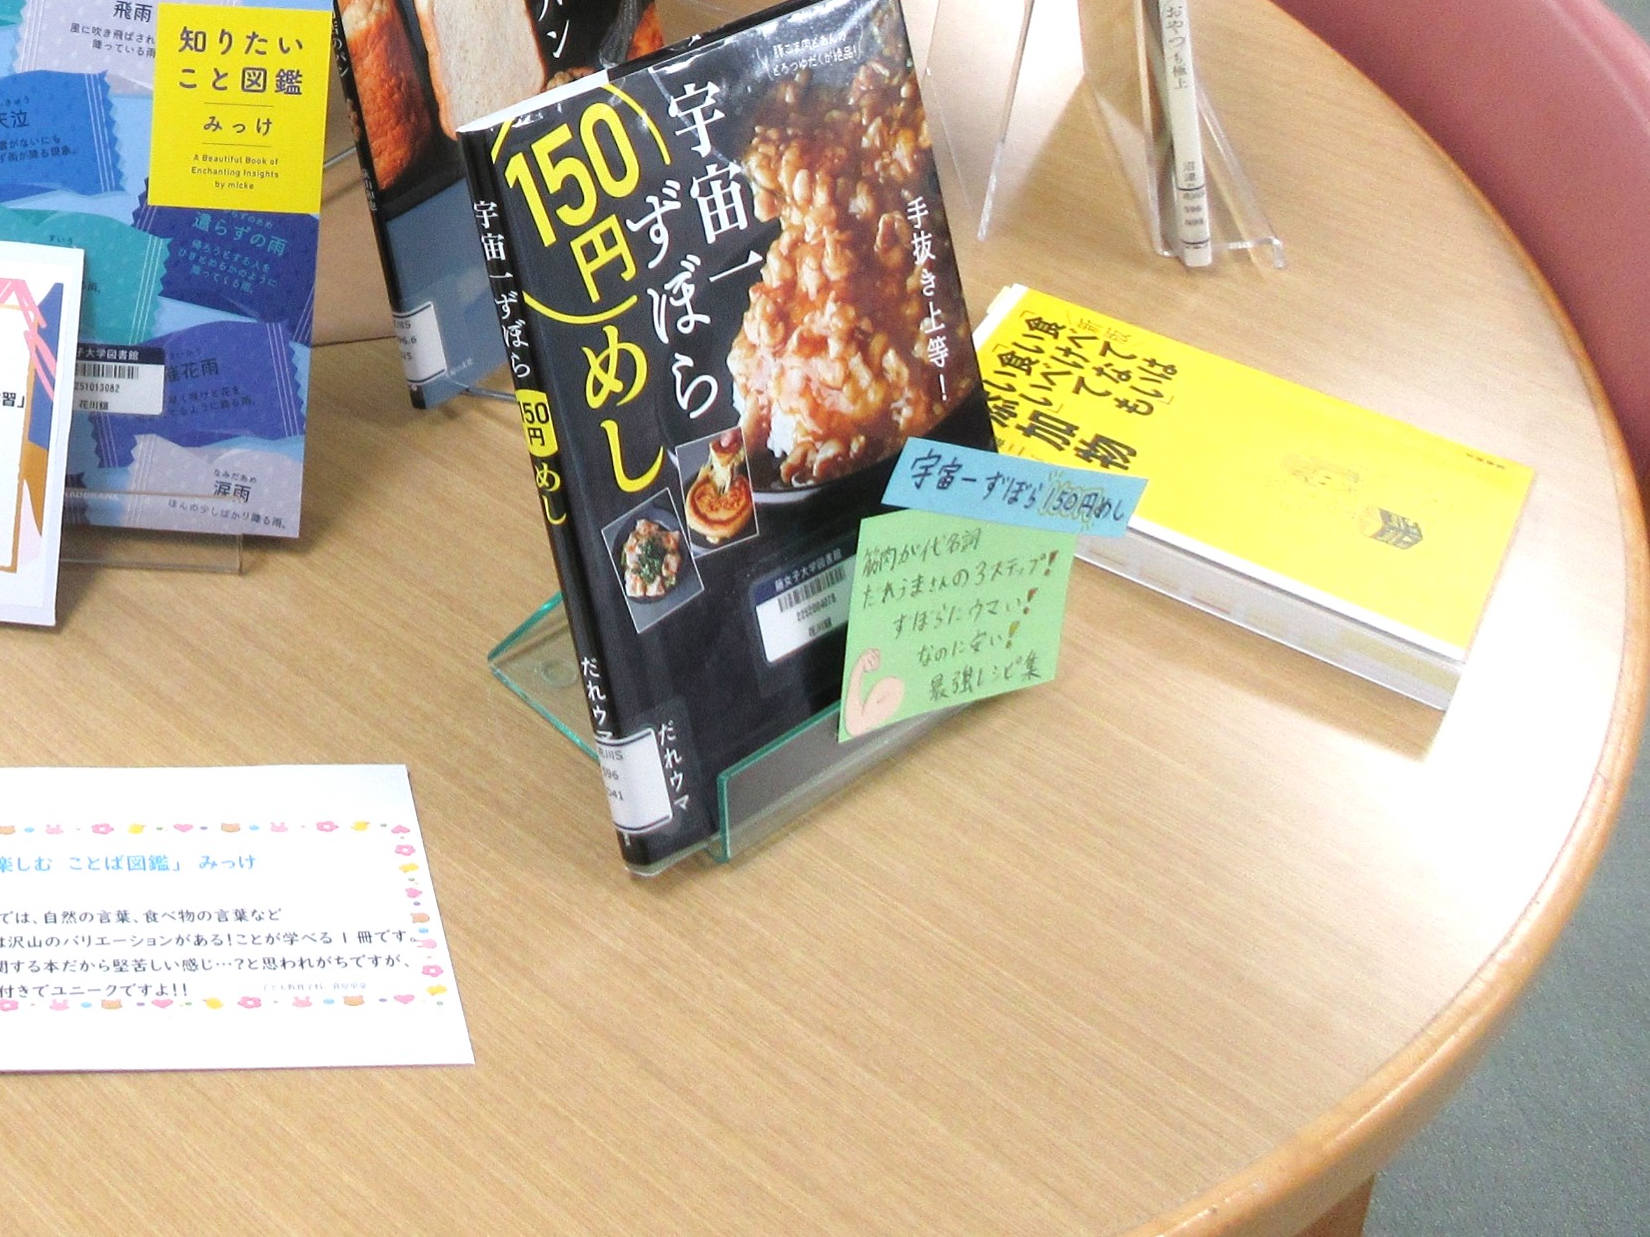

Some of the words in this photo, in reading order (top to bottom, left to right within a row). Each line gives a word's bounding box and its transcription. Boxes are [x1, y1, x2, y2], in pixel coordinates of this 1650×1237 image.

[113, 0, 153, 23] 飛雨
[178, 26, 303, 56] 知りたい
[178, 67, 303, 96] こと図鑑
[203, 115, 272, 137] みっけ
[192, 153, 200, 162] A
[202, 154, 243, 164] Beautiful
[245, 156, 267, 166] Book
[269, 158, 279, 166] of
[191, 166, 241, 178] Enchanting
[243, 168, 280, 180] Insights
[668, 80, 763, 285] 宇宙一
[214, 180, 226, 191] by
[626, 179, 719, 419] ずぼら
[658, 719, 690, 810] だれウマ
[68, 853, 182, 874] ことば図鑑」
[198, 852, 256, 872] みっけ
